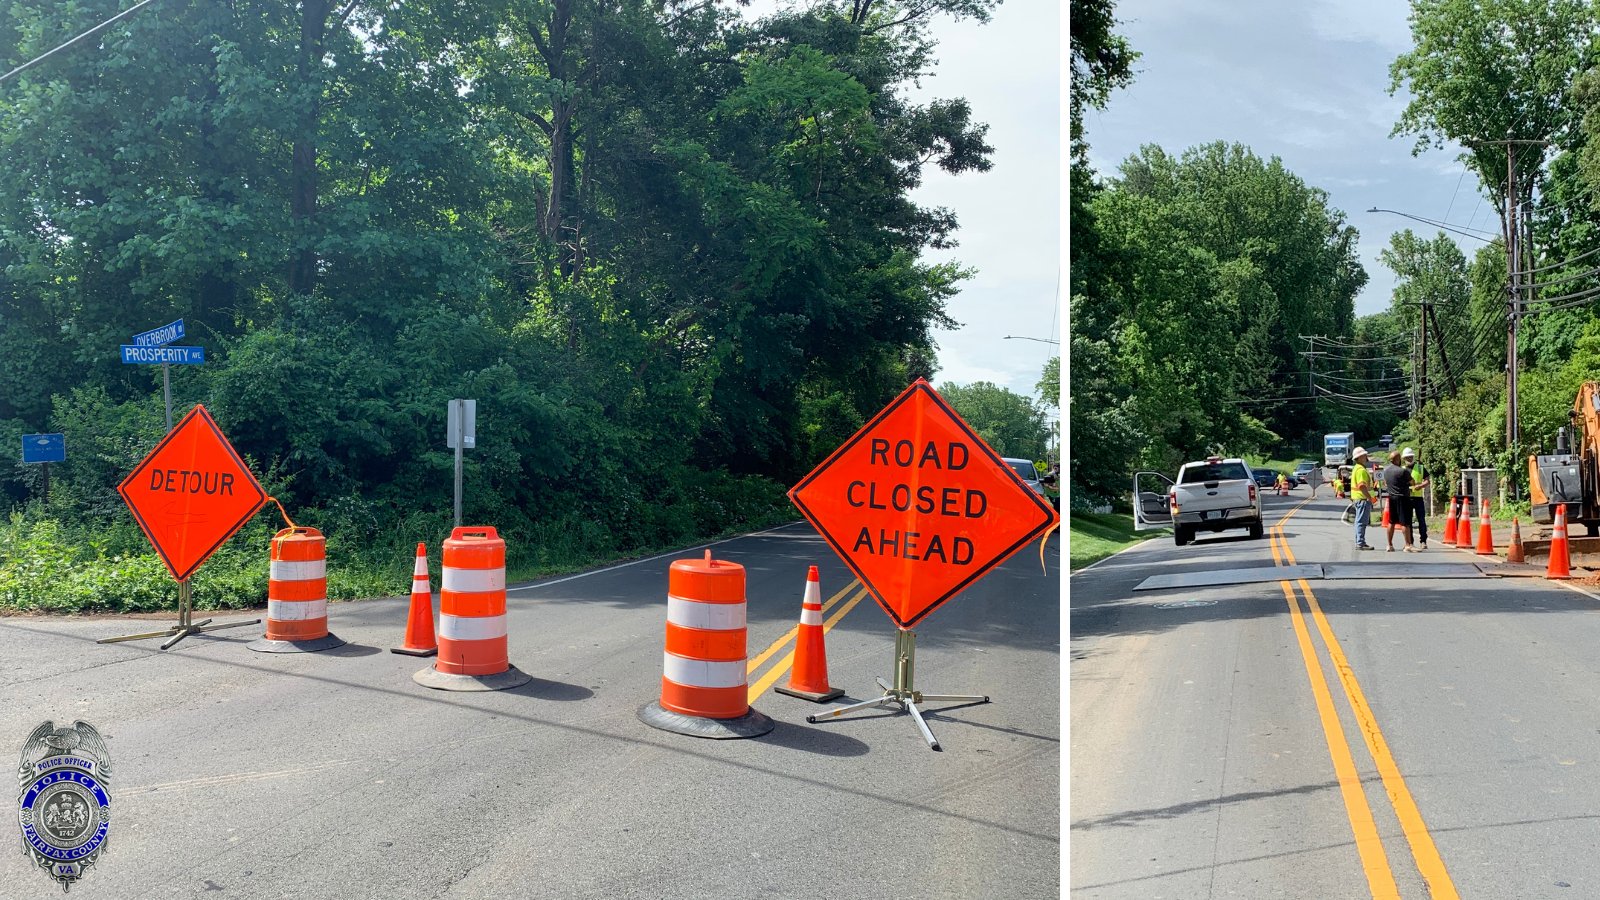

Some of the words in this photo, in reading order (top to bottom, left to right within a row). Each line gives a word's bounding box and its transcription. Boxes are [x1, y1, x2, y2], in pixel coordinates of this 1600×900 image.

[137, 325, 176, 346] OVERBROOK
[125, 347, 189, 362] PROSPERITY
[192, 351, 201, 359] AVE
[870, 438, 969, 471] ROAD
[150, 468, 235, 496] DETOUR
[846, 480, 988, 519] CLOSED
[852, 526, 975, 566] AHEAD
